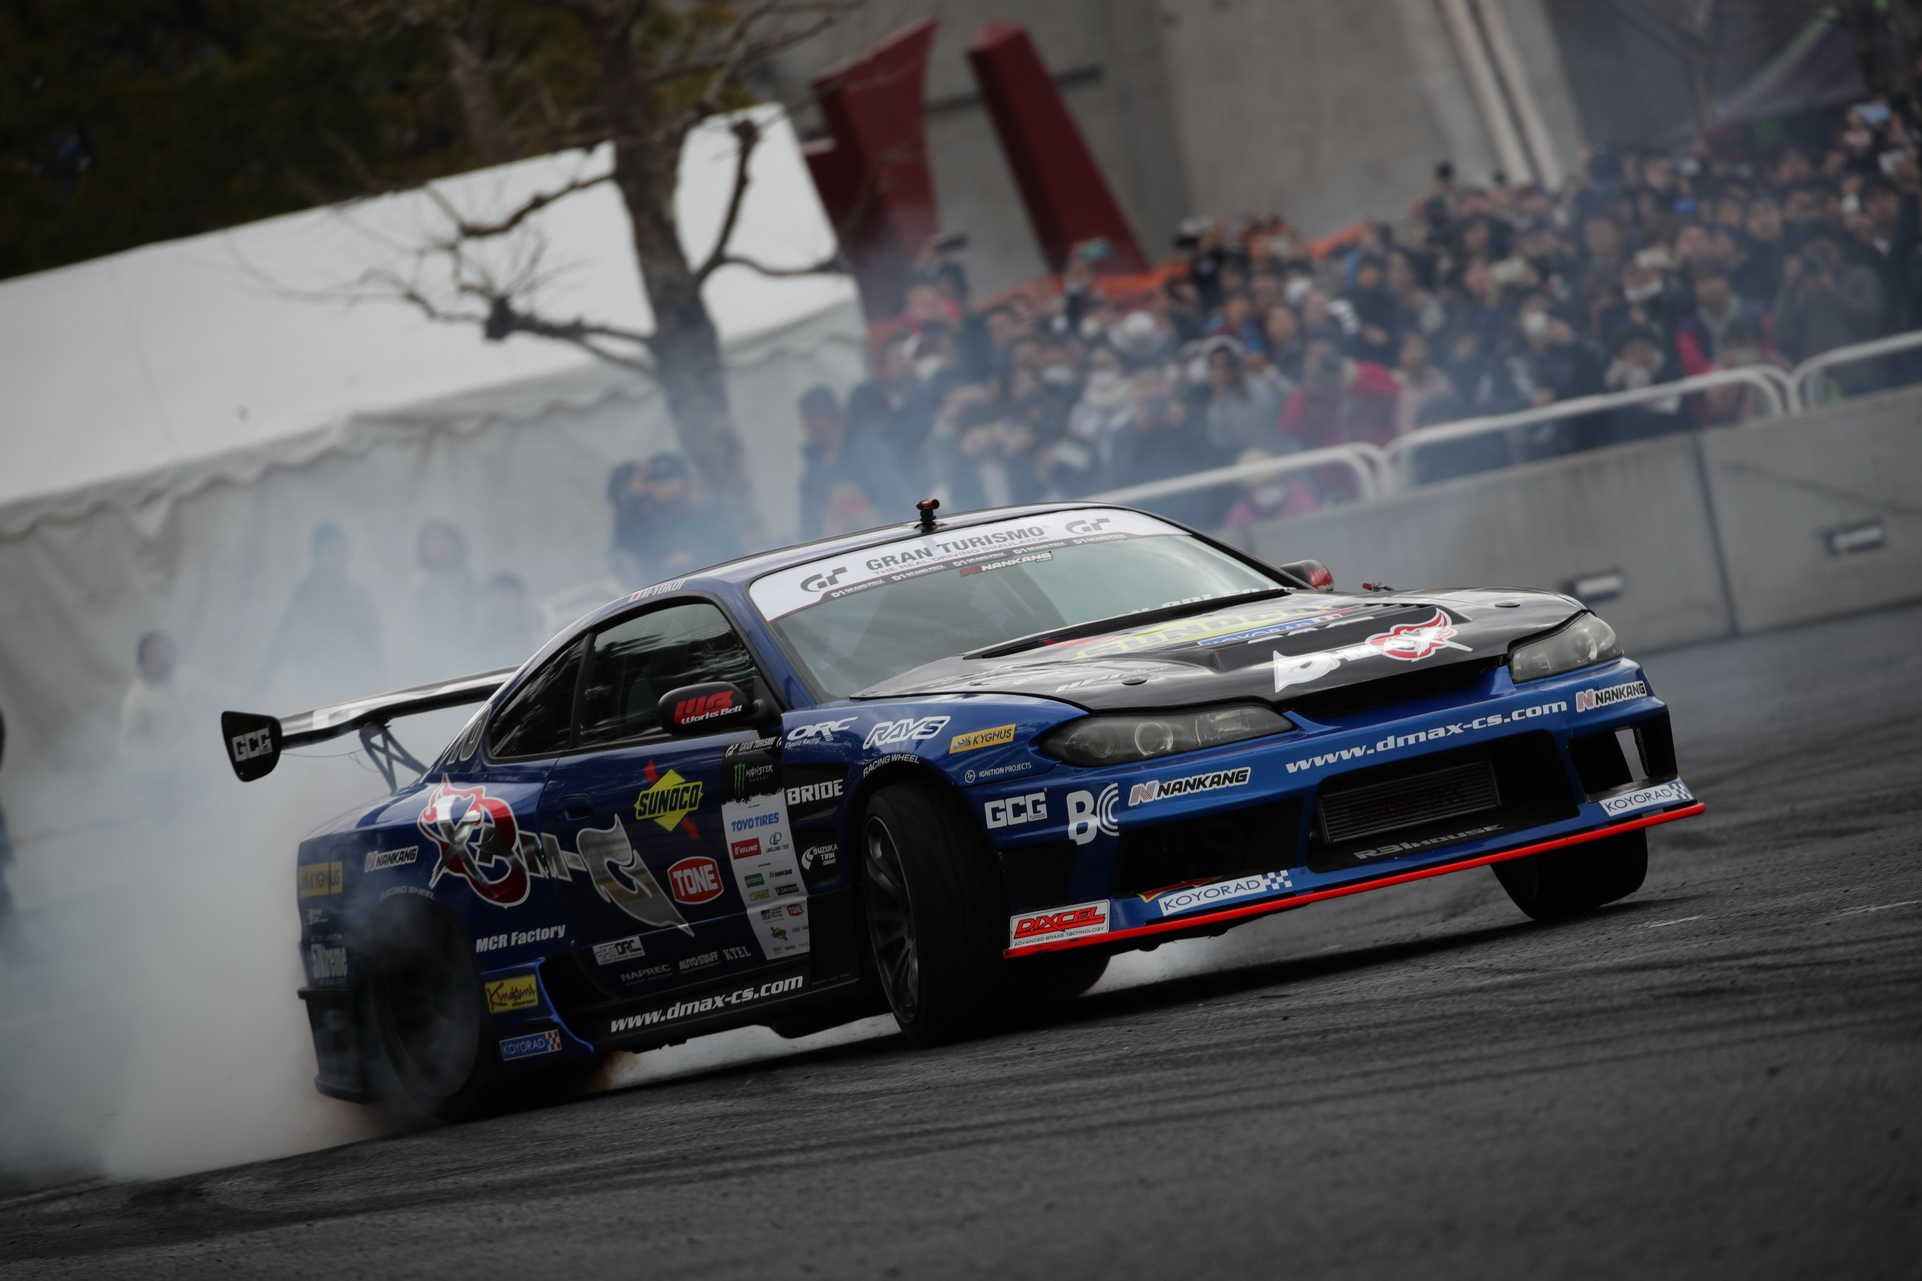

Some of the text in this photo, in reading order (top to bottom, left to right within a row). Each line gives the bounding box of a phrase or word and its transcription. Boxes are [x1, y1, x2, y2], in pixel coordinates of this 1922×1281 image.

[866, 526, 1045, 571] GRAN TURISMO
[896, 560, 929, 572] REAL
[931, 549, 976, 564] DRIVING
[978, 536, 1050, 551] SIMULATOR
[981, 552, 1053, 571] NANKANG
[1595, 683, 1646, 706] NANKANG
[681, 704, 743, 725] Works Bell
[232, 727, 274, 762] GCG
[787, 716, 858, 745] ORC
[863, 715, 951, 750] RAYS
[1285, 700, 1568, 773] www.dmax-cs.com
[863, 753, 921, 778] RACING WHEEL
[979, 761, 1032, 779] IGNITION PROJECTS
[786, 779, 844, 807] BRIDE
[1157, 769, 1250, 798] NANKANG
[636, 784, 703, 822] SUNOCO
[984, 792, 1048, 829] GCG
[1604, 788, 1672, 812] KOYORAD
[731, 812, 780, 832] TOYO TIRES
[376, 847, 418, 868] NANKANG
[813, 842, 838, 856] SUZUKA
[820, 851, 836, 861] TWIN
[408, 885, 436, 901] WHEEL
[672, 866, 720, 898] TONE
[1163, 880, 1261, 911] KOYORAD
[1014, 907, 1106, 939] DIXCEL
[1014, 926, 1106, 947] ADVANCED BRAKE TECHNOLOGY
[476, 924, 567, 953] MCR Factory
[620, 963, 672, 981] NAPREC
[611, 974, 804, 1032] www.dmax-cs.com
[503, 1039, 546, 1055] KOYORAD
